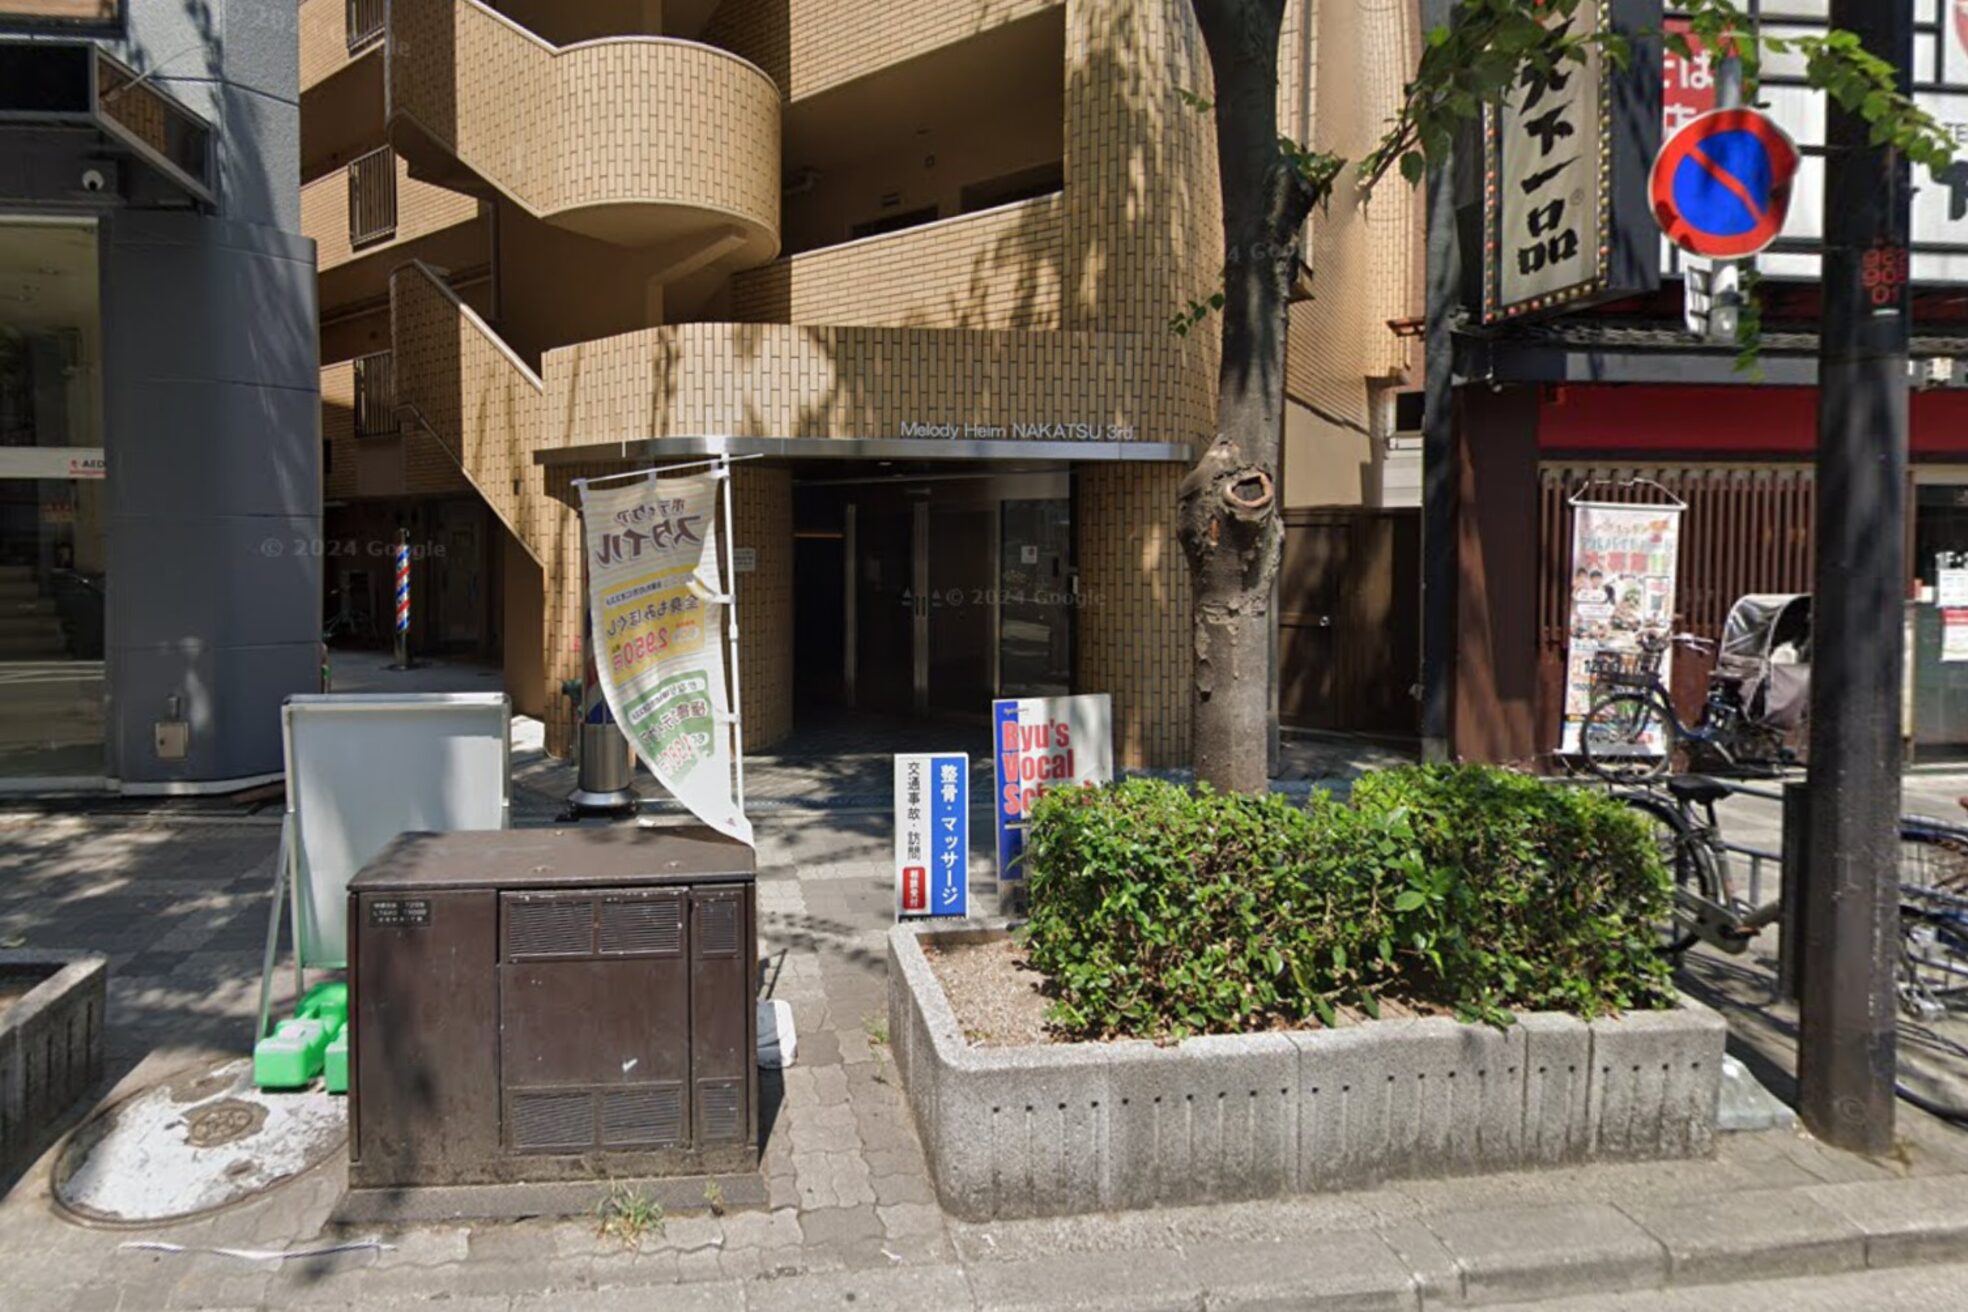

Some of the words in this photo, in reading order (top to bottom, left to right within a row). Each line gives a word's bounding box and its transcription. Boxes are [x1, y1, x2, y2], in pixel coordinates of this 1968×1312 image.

[901, 421, 959, 440] Melody
[964, 422, 1007, 438] Heim
[1013, 423, 1101, 439] NAKATSU
[1002, 719, 1071, 753] Ryu's
[1002, 749, 1075, 783] Vocal
[907, 762, 922, 861] 交通事故・訪問
[940, 764, 959, 905] 整骨・マッサージ
